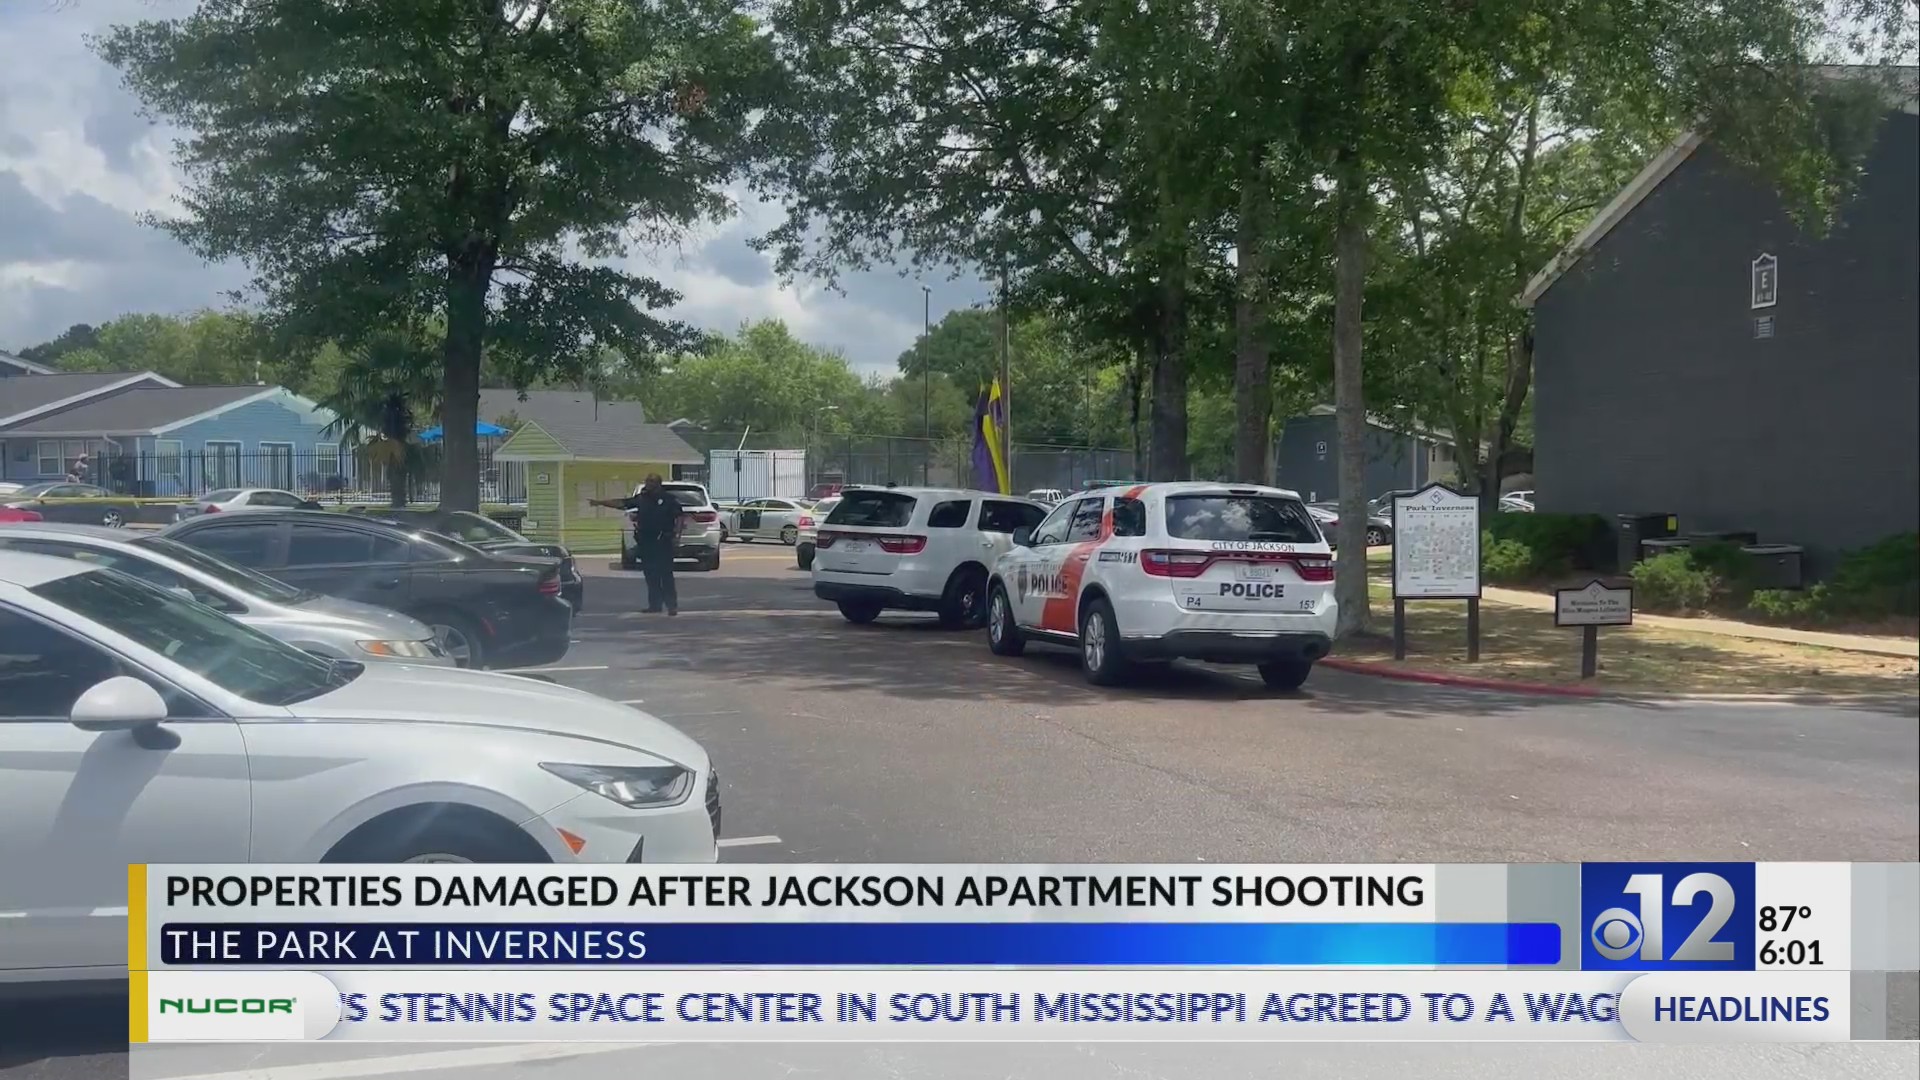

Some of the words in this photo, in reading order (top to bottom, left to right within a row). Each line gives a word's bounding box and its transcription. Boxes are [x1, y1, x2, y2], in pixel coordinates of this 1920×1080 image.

[1761, 272, 1768, 289] E
[1212, 541, 1234, 550] CITY
[1236, 542, 1249, 550] OF
[1252, 542, 1295, 552] JACKSON
[1030, 573, 1069, 595] POLICE
[1220, 583, 1285, 598] POLICE
[1186, 597, 1201, 607] P4
[1300, 600, 1315, 609] 153
